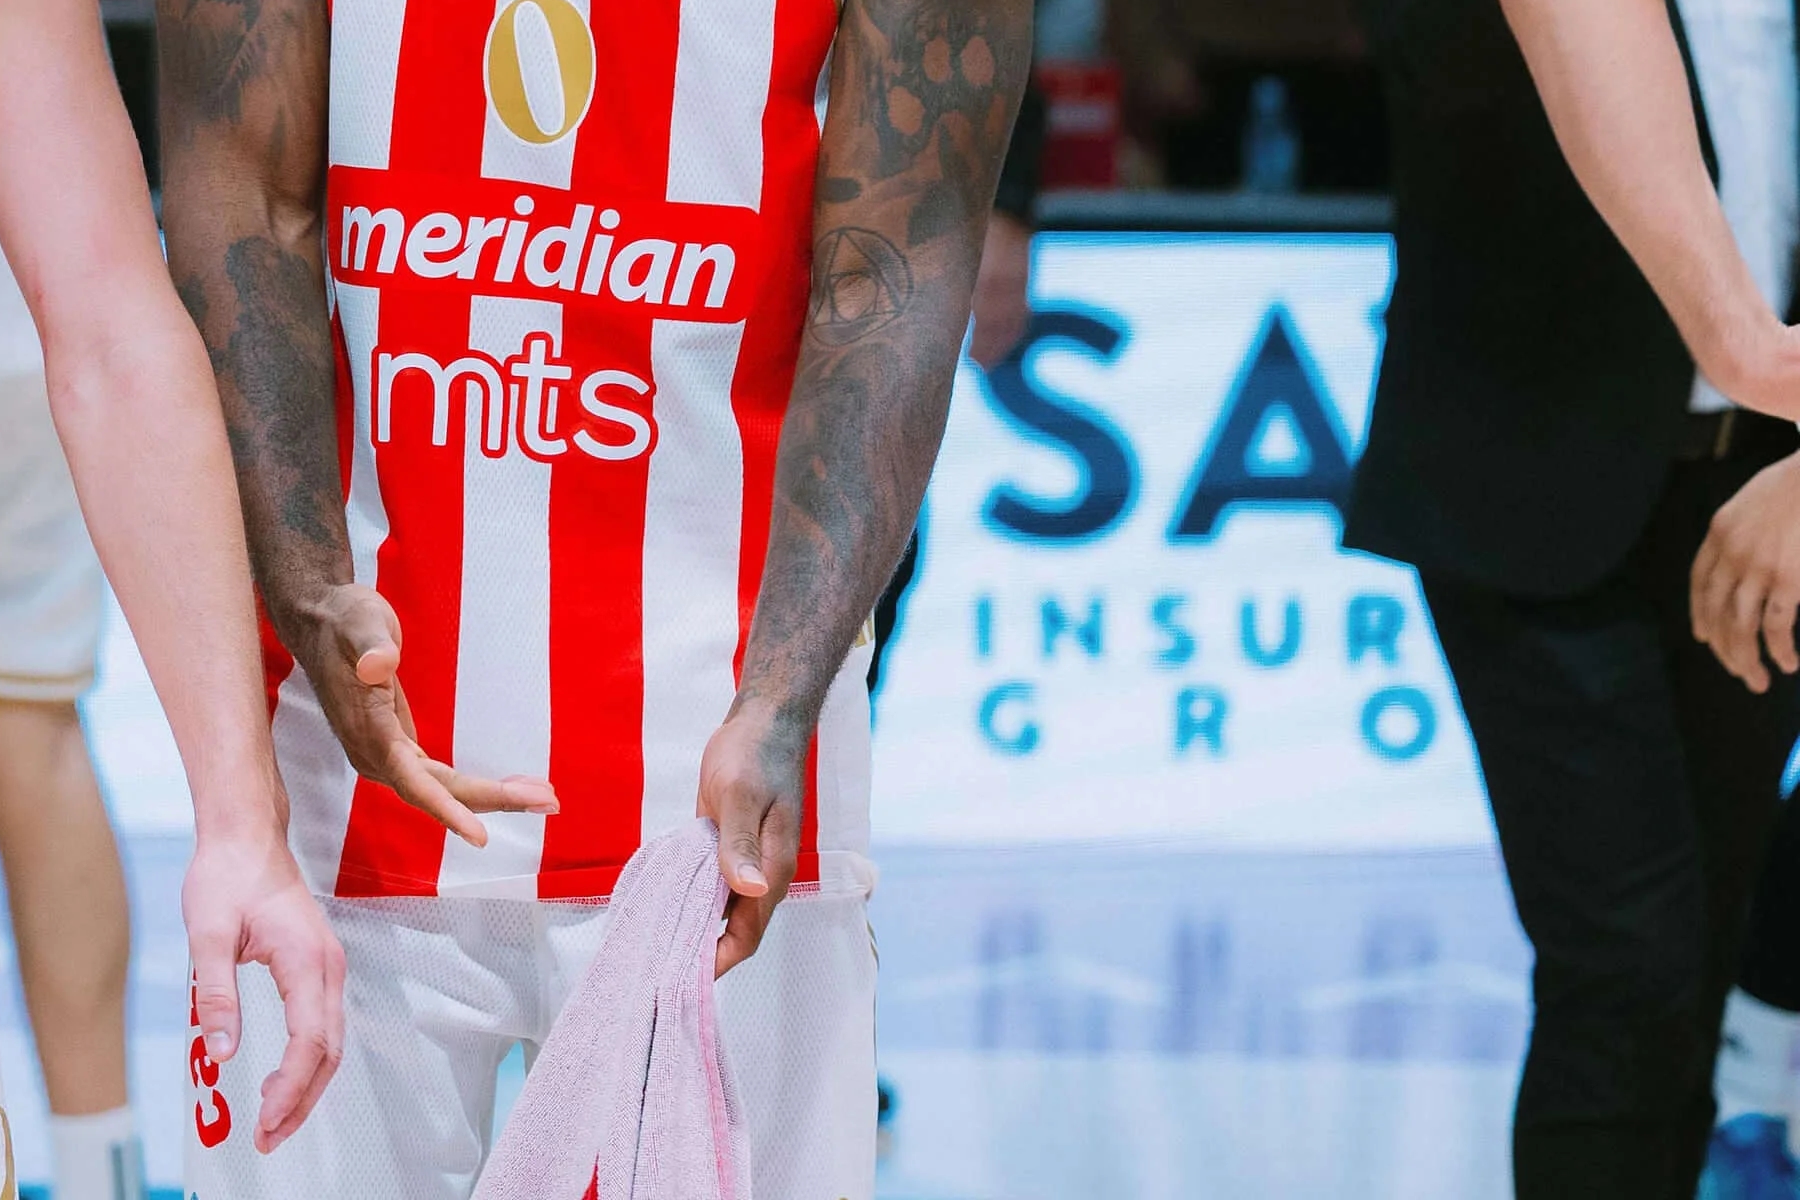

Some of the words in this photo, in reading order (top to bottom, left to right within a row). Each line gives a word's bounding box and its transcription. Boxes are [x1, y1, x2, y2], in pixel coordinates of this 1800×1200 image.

[339, 195, 736, 308] meridian
[377, 340, 654, 462] mts
[978, 683, 1438, 762] GRO
